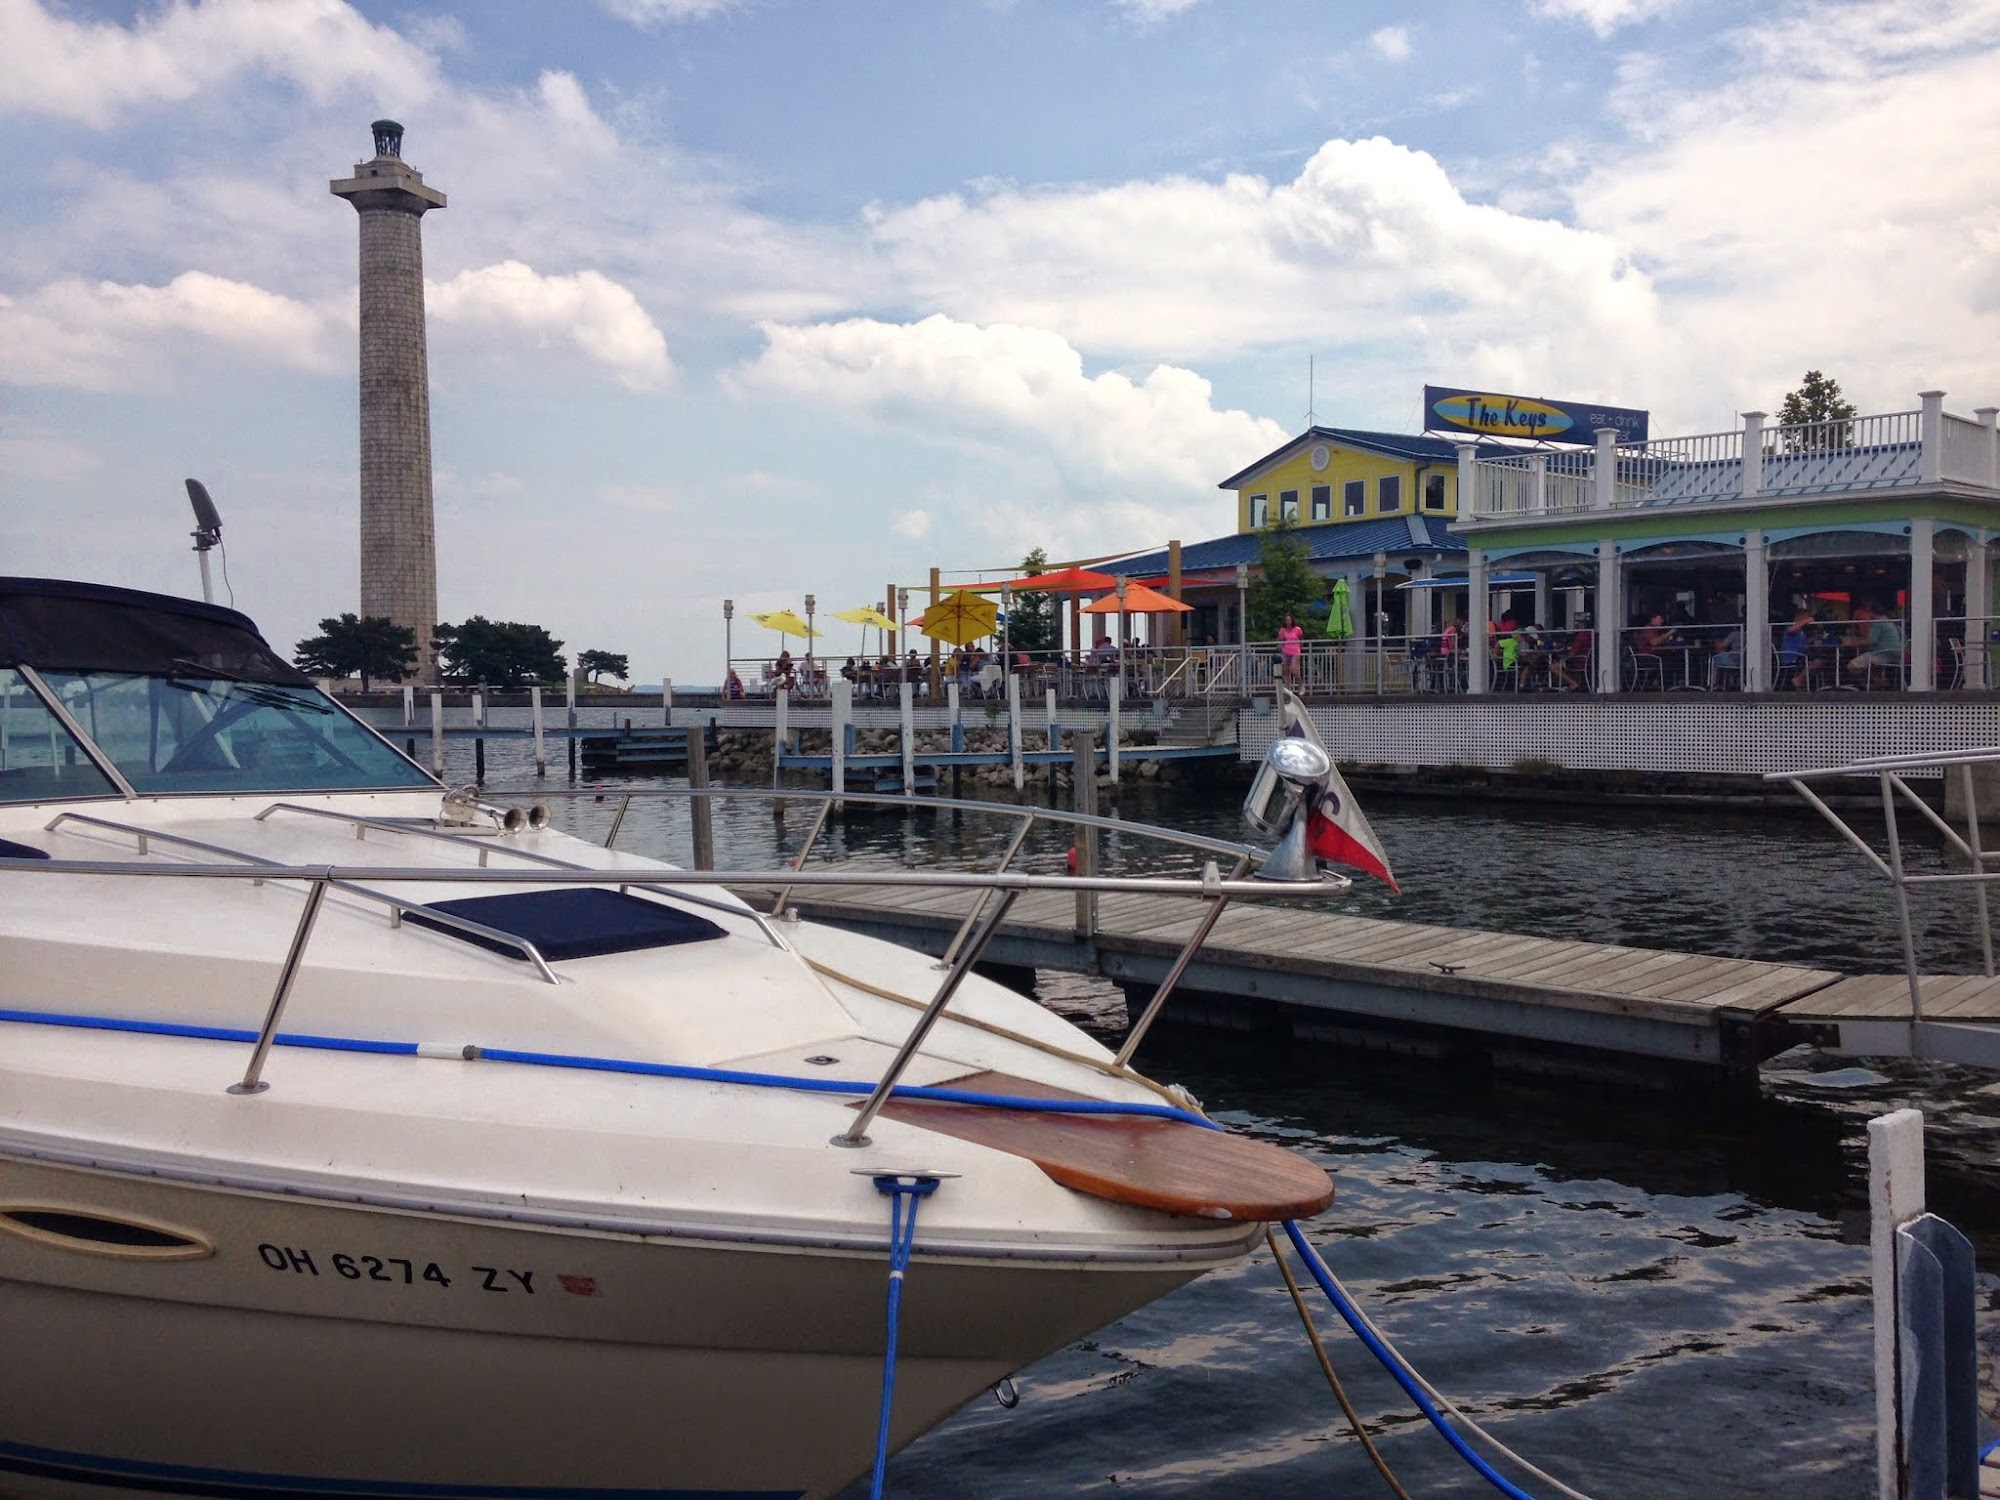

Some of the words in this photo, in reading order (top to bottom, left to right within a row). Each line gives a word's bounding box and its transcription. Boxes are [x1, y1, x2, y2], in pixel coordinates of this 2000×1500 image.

[1466, 397, 1499, 426] The
[1504, 399, 1547, 435] Keys
[1590, 413, 1606, 424] eat
[1615, 413, 1640, 428] drink
[258, 1243, 319, 1276] OH
[332, 1253, 451, 1288] 6274
[471, 1266, 534, 1294] ZY
